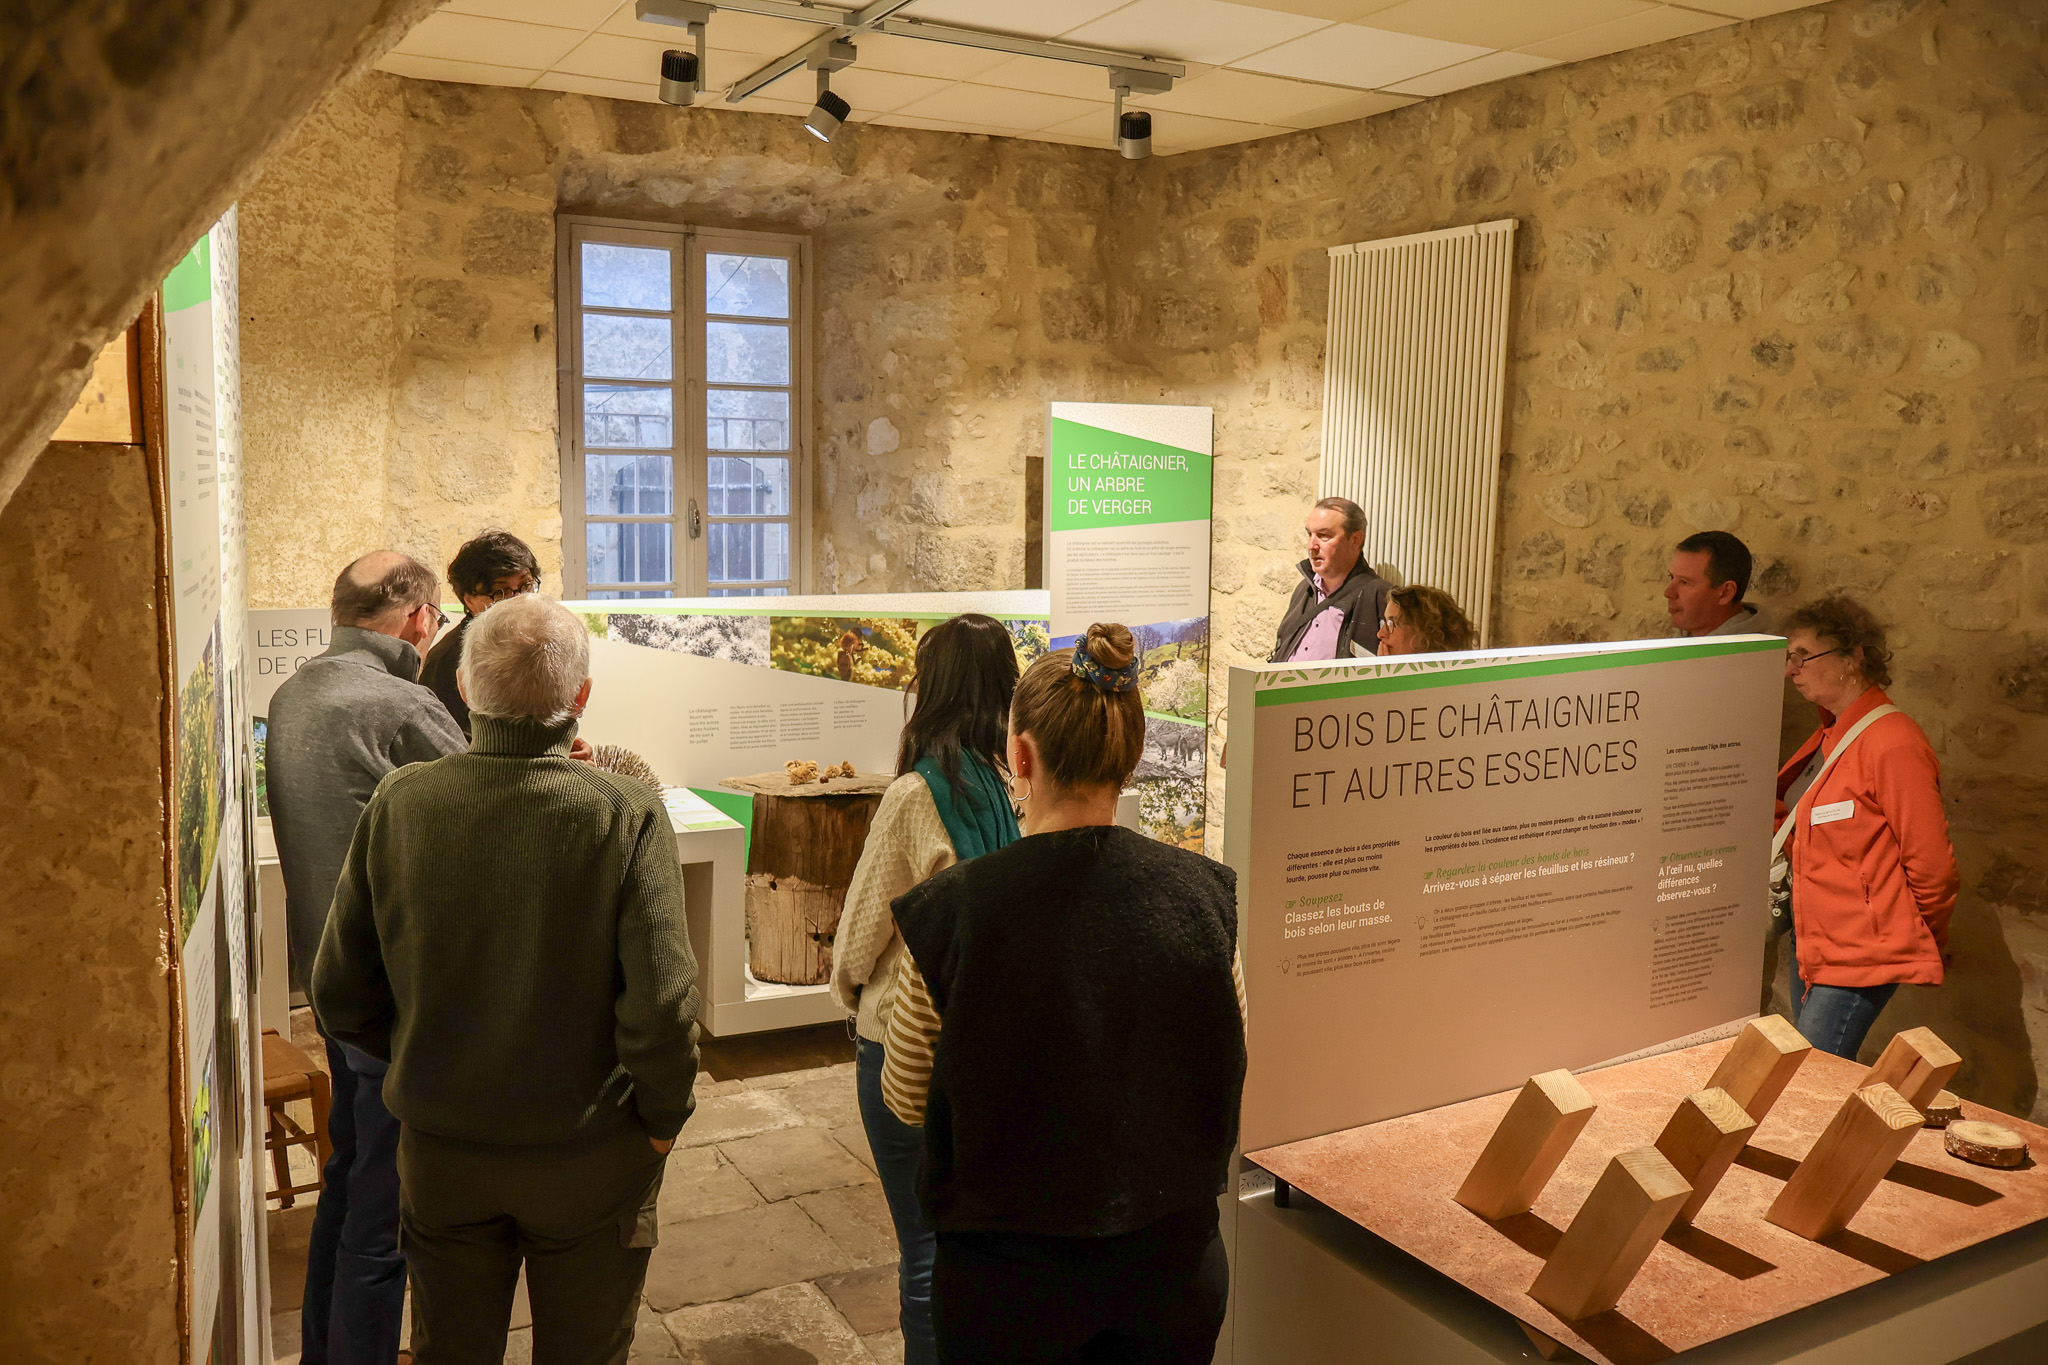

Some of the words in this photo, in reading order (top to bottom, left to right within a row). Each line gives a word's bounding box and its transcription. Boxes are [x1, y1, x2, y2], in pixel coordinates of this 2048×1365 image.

[1068, 454, 1086, 470] LE
[1090, 451, 1189, 472] CHÂTAIGNIER,
[1068, 477, 1091, 492] UN
[1095, 477, 1145, 492] ARBRE
[1068, 499, 1088, 515] DE
[1092, 499, 1152, 515] VERGER
[257, 629, 298, 648] LES
[306, 628, 330, 646] FL
[258, 657, 288, 675] DE
[1294, 712, 1374, 753] BOIS
[1386, 707, 1427, 744] DE
[1438, 690, 1640, 739] CHÂTAIGNIER
[1292, 770, 1335, 809] ET
[1343, 756, 1475, 803] AUTRES
[1485, 739, 1637, 786] ESSENCES
[1433, 833, 1453, 841] couleur
[1519, 822, 1530, 830] plus
[1553, 817, 1574, 826] présents
[1612, 809, 1634, 817] incidence
[1287, 852, 1309, 860] Chaque
[1310, 849, 1334, 857] essence
[1372, 840, 1400, 850] propriétés
[1286, 862, 1318, 872] différentes
[1344, 857, 1356, 865] plus
[1422, 878, 1480, 894] Arrivez-vous
[1482, 874, 1487, 885] à
[1489, 871, 1522, 885] séparer
[1524, 868, 1536, 879] les
[1538, 863, 1569, 876] feuillus
[1571, 861, 1579, 871] et
[1581, 859, 1593, 870] les
[1594, 855, 1628, 868] résineux
[1630, 852, 1635, 862] ?
[1436, 864, 1476, 880] Regardez
[1478, 862, 1486, 872] la
[1488, 858, 1520, 871] couleur
[1521, 855, 1535, 866] des
[1537, 852, 1560, 862] bouts
[1561, 849, 1571, 860] de
[1573, 848, 1589, 857] bois
[1658, 867, 1665, 877] A
[1666, 863, 1683, 876] l'œil
[1684, 864, 1695, 873] nu,
[1697, 858, 1723, 872] quelles
[1286, 875, 1306, 883] lourde,
[1307, 872, 1328, 882] pousse
[1329, 870, 1341, 879] plus
[1351, 866, 1368, 874] moins
[1657, 876, 1700, 890] différences
[1299, 893, 1343, 908] Soupesez
[1656, 886, 1711, 903] observez-vous
[1712, 883, 1717, 893] ?
[1285, 910, 1324, 924] Classez
[1327, 906, 1341, 918] les
[1344, 902, 1371, 915] bouts
[1373, 899, 1385, 910] de
[1284, 926, 1306, 939] bois
[1308, 922, 1335, 935] selon
[1338, 919, 1357, 930] leur
[1359, 914, 1393, 927] masse.
